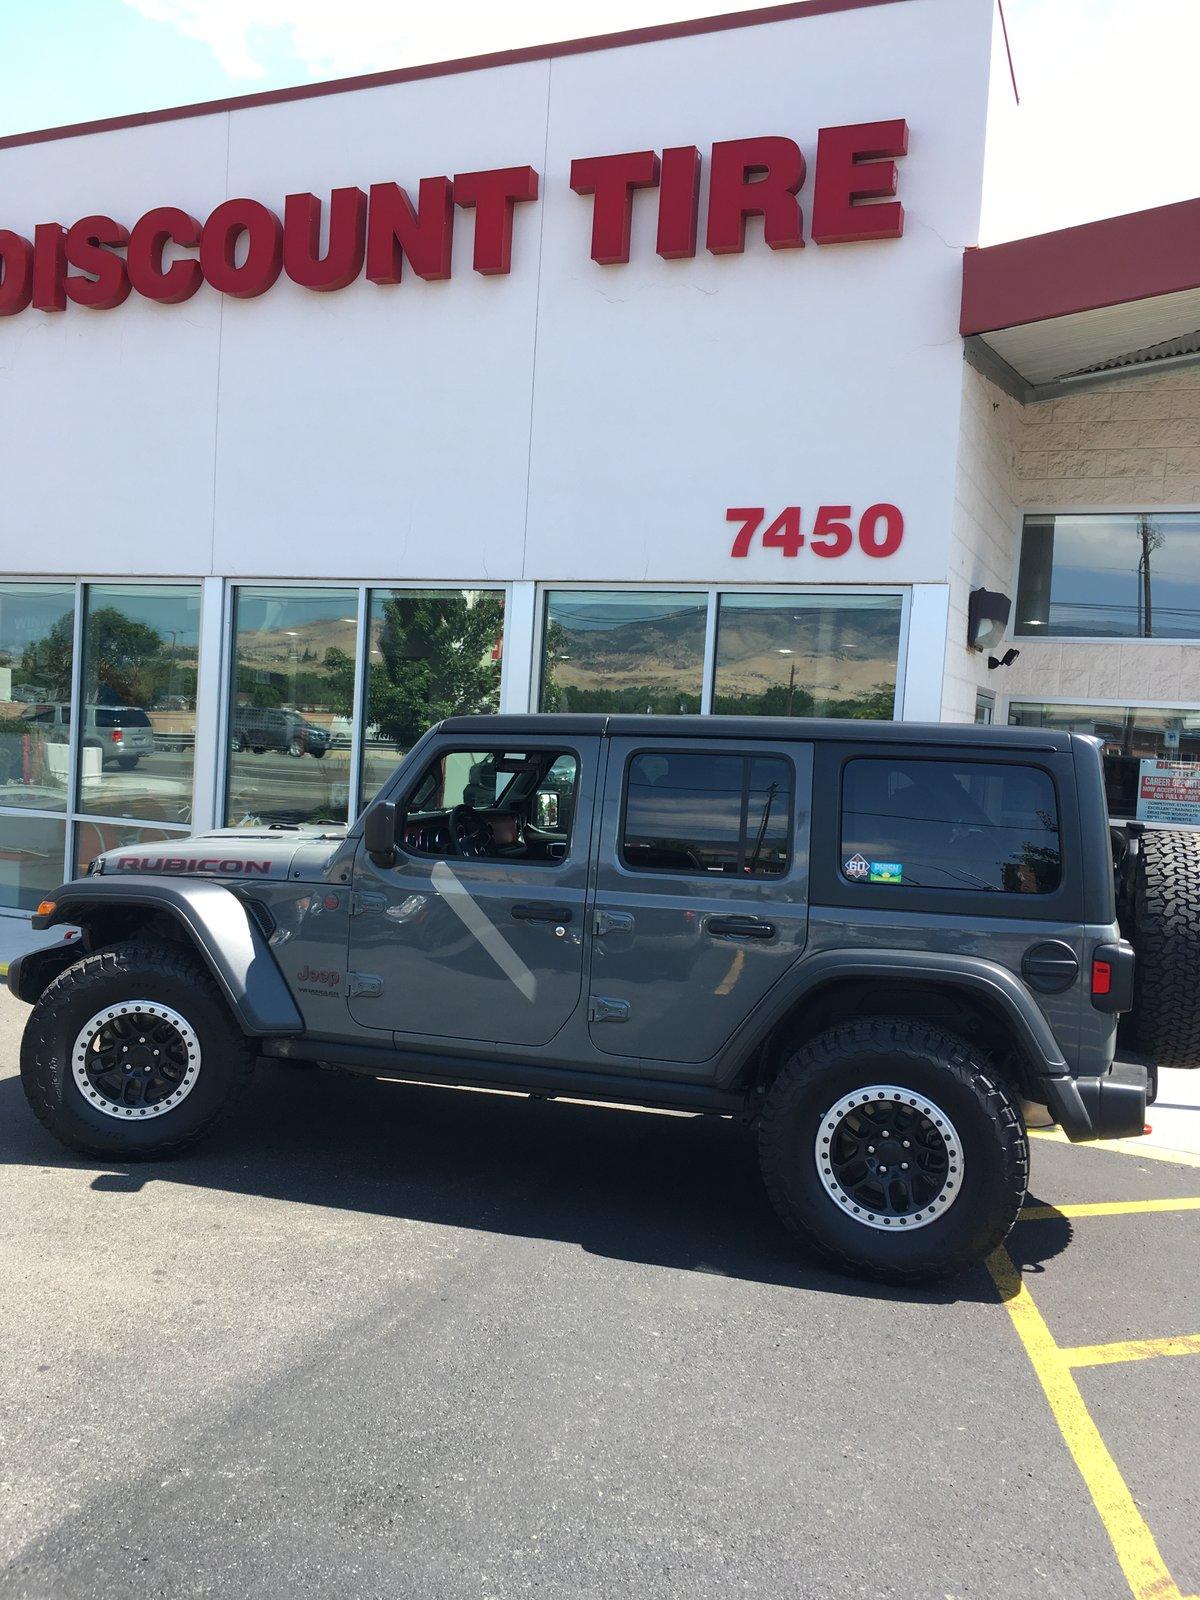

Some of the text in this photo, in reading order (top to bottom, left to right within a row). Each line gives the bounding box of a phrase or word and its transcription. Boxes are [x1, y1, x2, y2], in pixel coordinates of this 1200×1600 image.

[569, 118, 909, 265] TIRE
[726, 503, 904, 558] 7450
[1145, 777, 1171, 787] CAREER
[1156, 787, 1187, 795] ACCEPTING
[116, 857, 273, 874] RUBICON
[849, 861, 865, 871] 60
[297, 965, 340, 987] Jeep
